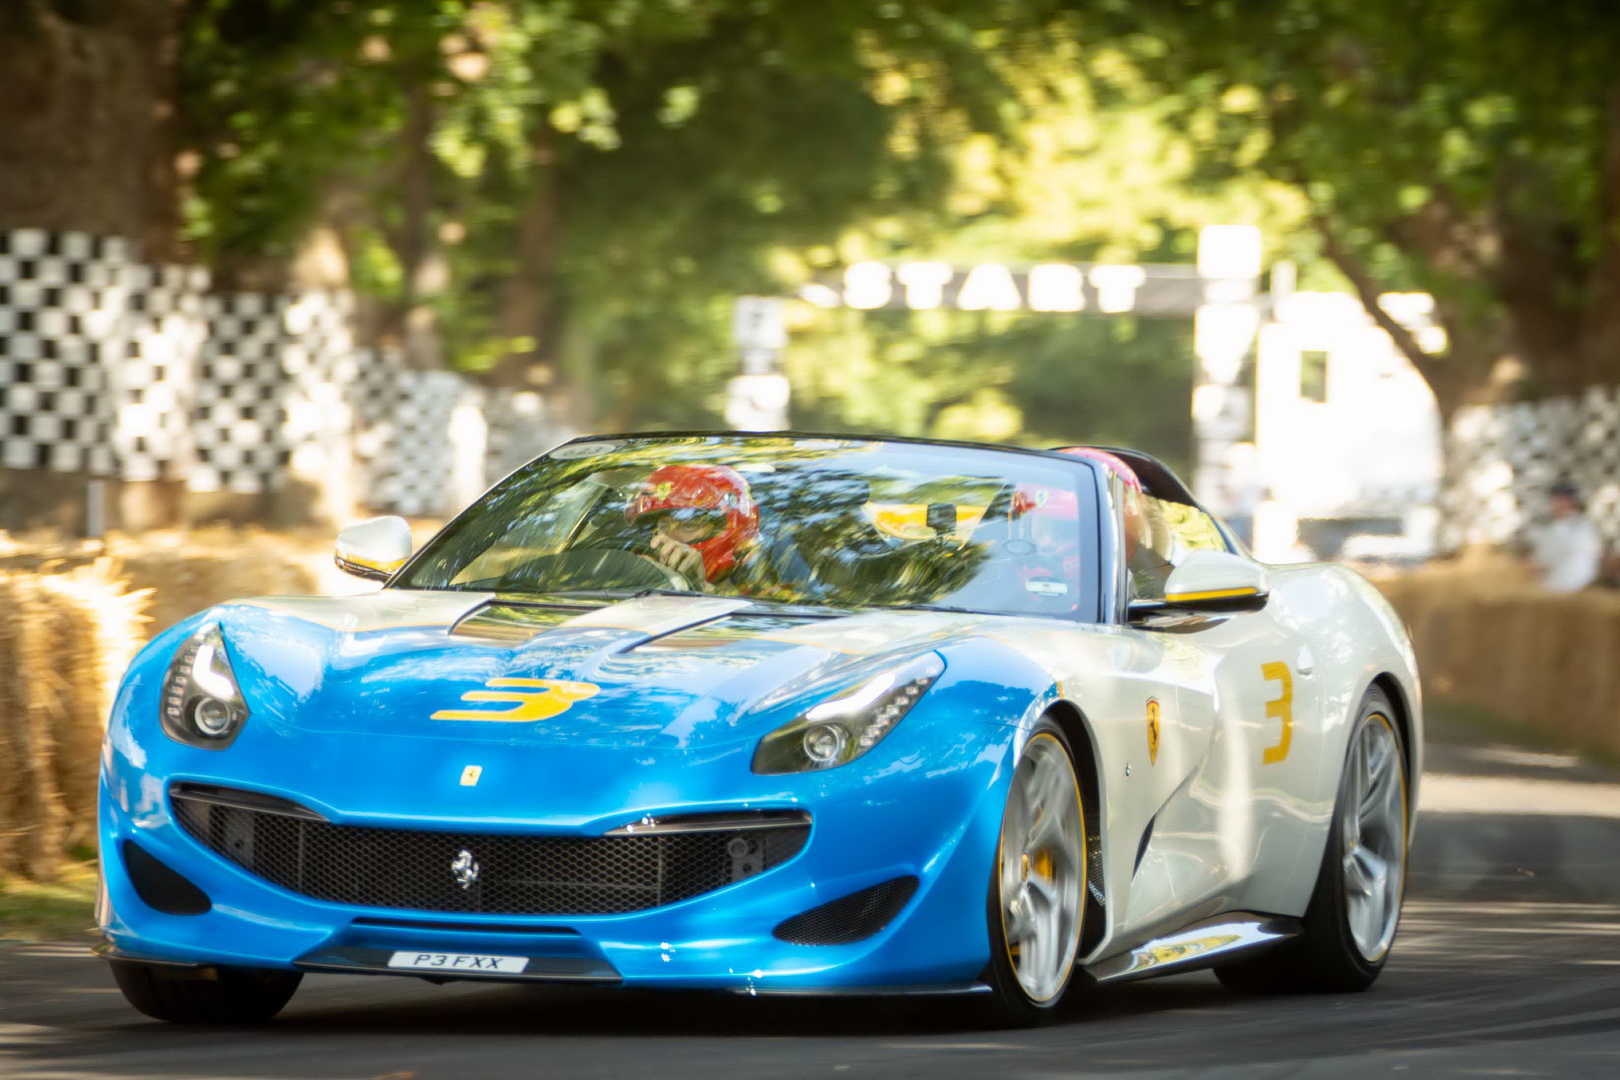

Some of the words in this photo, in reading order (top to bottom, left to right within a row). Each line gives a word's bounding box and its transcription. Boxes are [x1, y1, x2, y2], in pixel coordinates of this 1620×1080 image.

[843, 261, 1146, 313] START
[430, 677, 600, 722] 3
[1261, 661, 1293, 765] 3
[413, 954, 449, 966] P3
[452, 955, 504, 969] FXX
